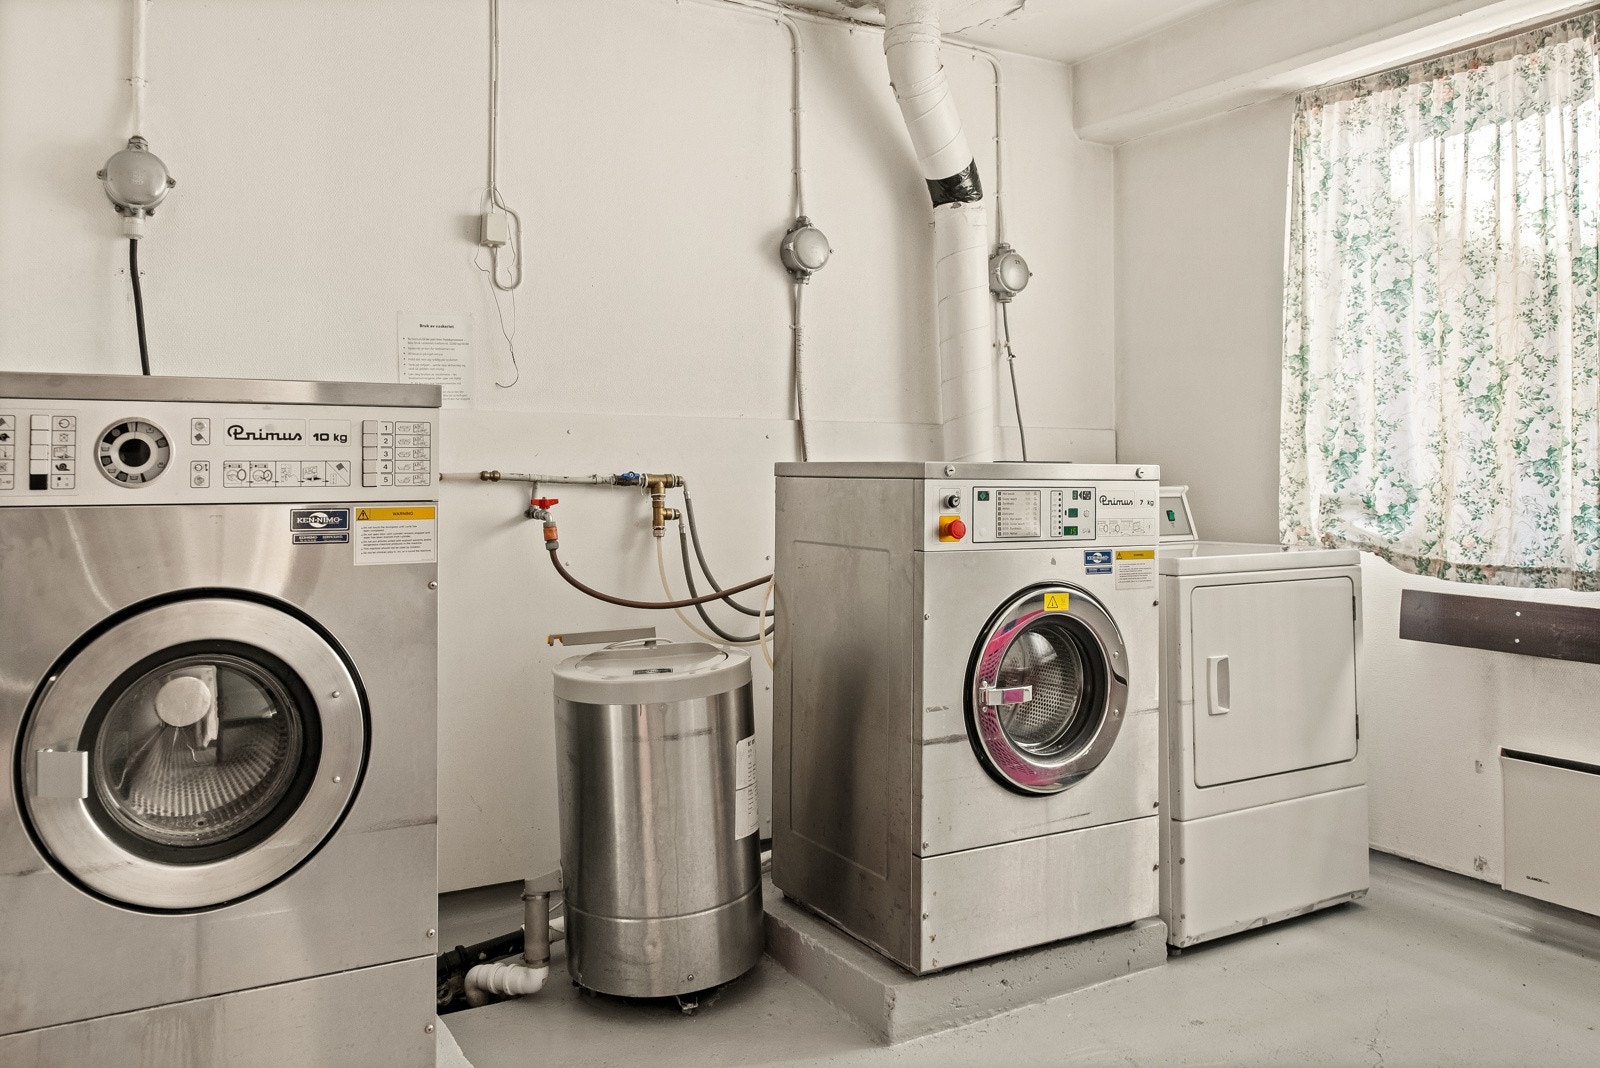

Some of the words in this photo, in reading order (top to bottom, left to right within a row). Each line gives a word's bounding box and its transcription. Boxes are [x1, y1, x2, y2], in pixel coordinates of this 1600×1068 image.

[227, 424, 303, 441] Primus
[312, 432, 329, 442] 10
[333, 432, 348, 444] kg
[1099, 494, 1134, 506] Primus
